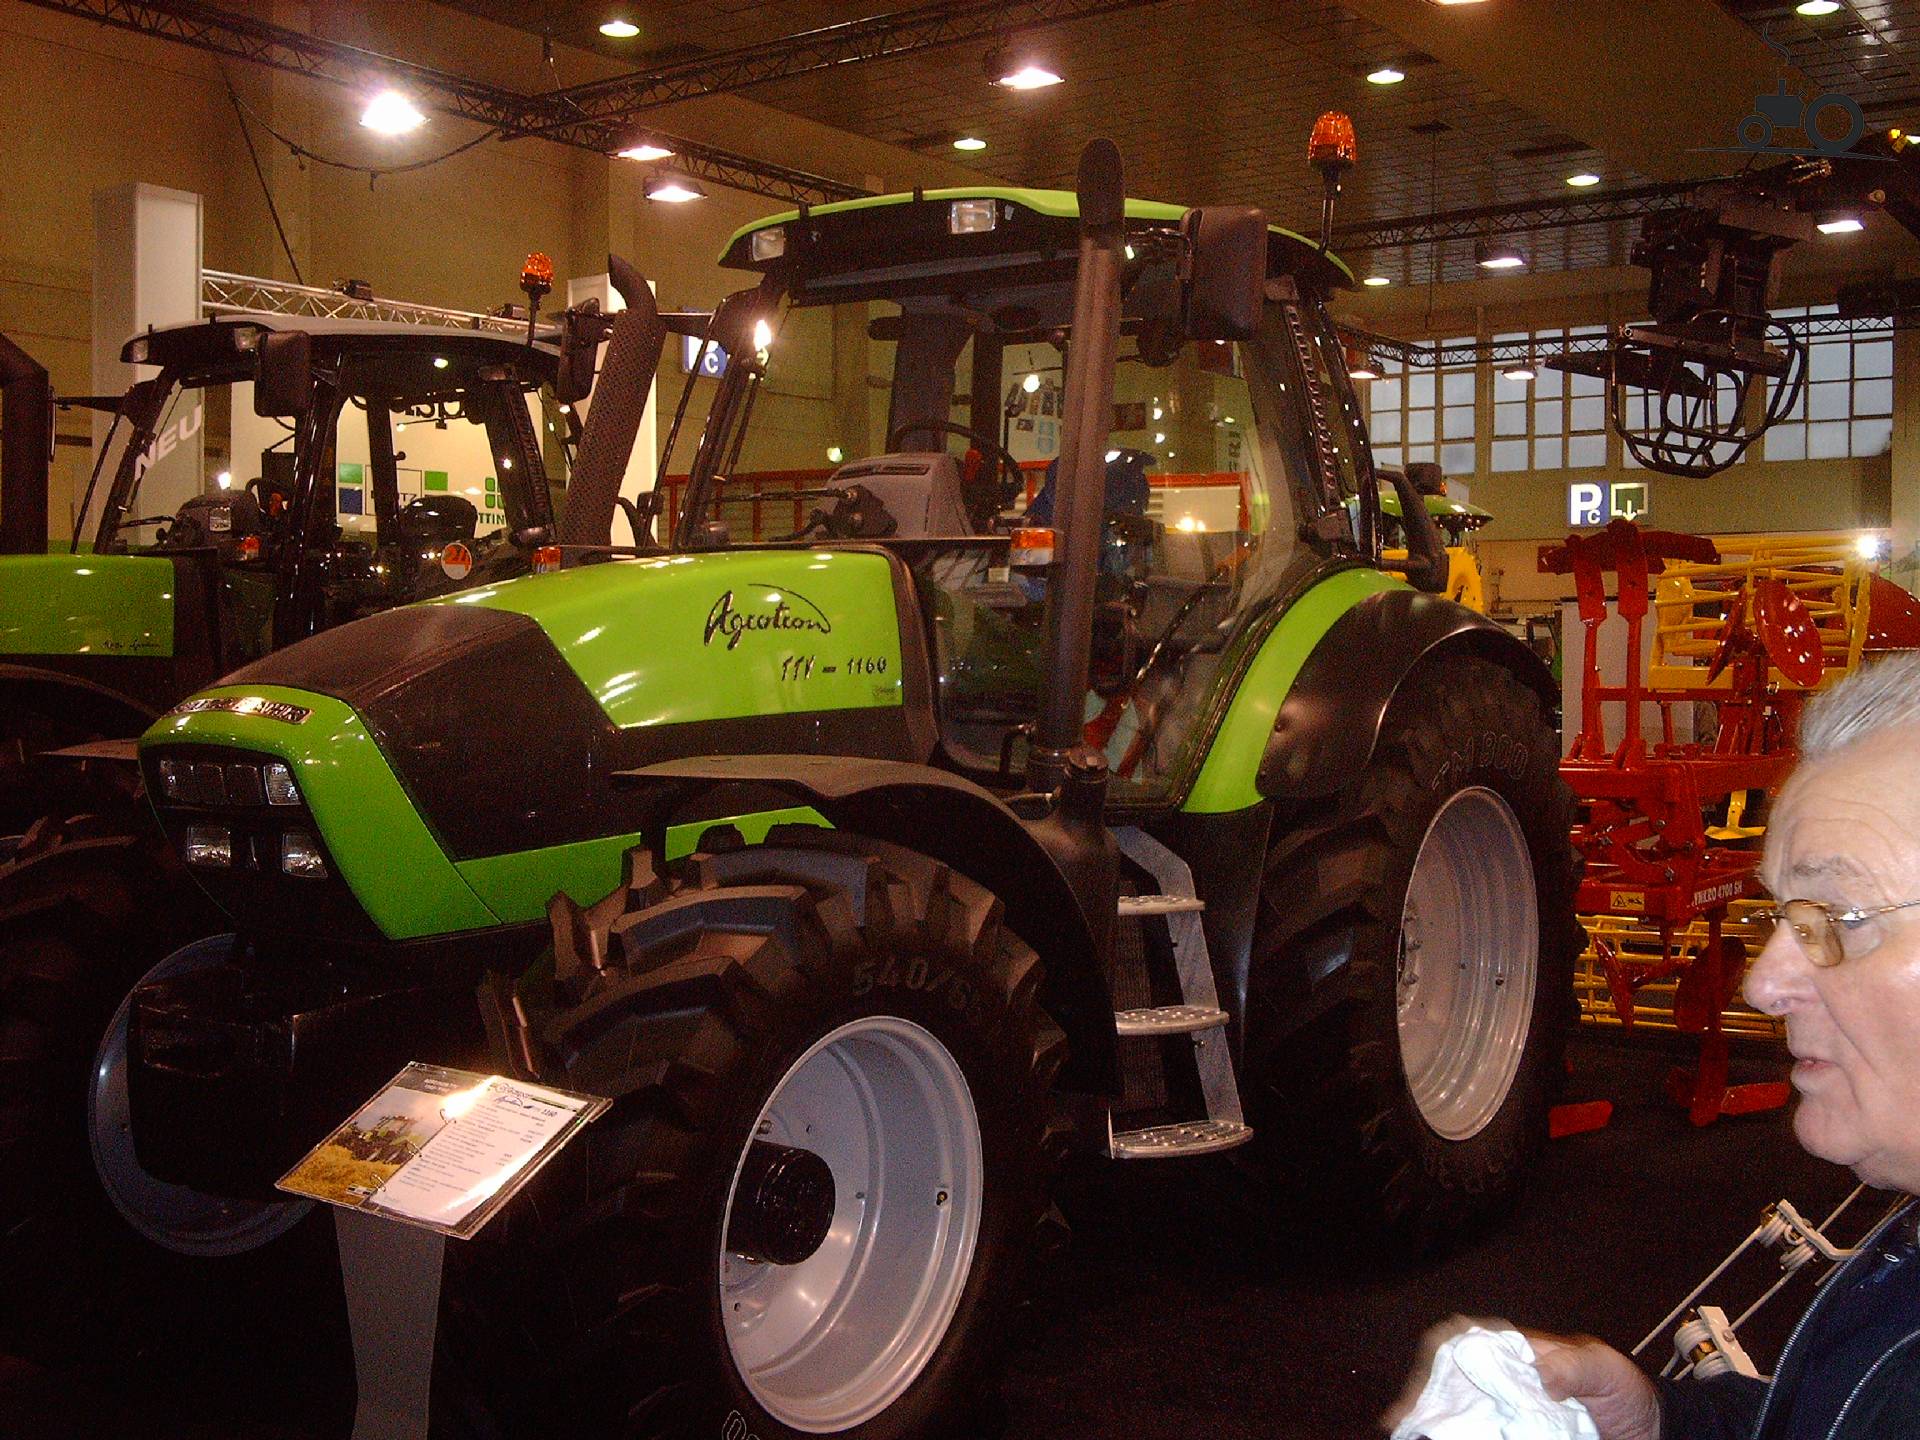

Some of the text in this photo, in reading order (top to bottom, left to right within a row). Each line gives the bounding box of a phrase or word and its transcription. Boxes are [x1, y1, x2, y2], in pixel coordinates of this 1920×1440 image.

[134, 404, 202, 481] NEU
[478, 512, 505, 525] TTIN
[703, 583, 832, 651] Agrotron
[847, 656, 888, 676] 1160
